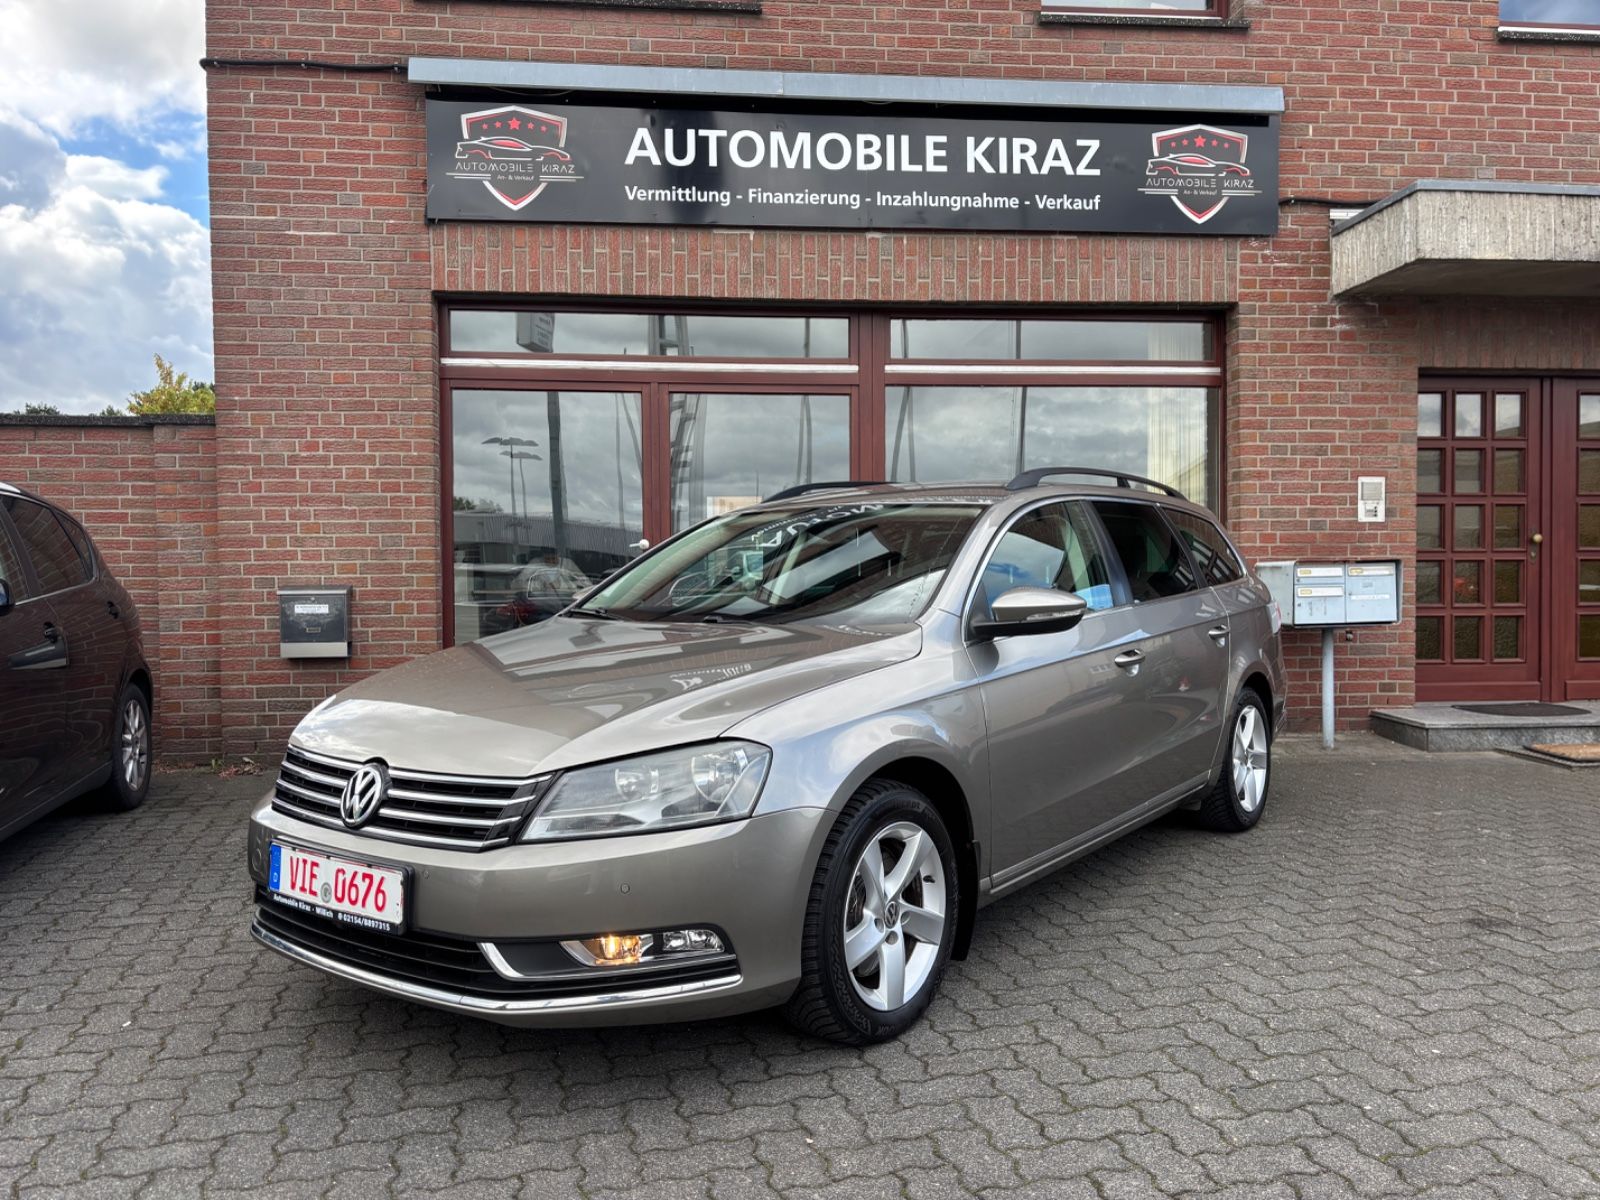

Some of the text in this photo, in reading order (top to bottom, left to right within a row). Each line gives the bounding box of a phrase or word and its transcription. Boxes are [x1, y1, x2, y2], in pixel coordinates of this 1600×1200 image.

[624, 127, 1101, 176] AUTOMOBILE KIRAZ
[455, 161, 575, 174] AUTOMOBILE KIRAZ
[1146, 177, 1254, 188] AUTOMOBILE KIRAZ
[624, 185, 731, 207] Vermittlung
[748, 187, 861, 211] Finanzierung
[876, 190, 1020, 213] Inzahlungnahme
[1034, 194, 1102, 211] Verkauf
[289, 854, 388, 913] VIE 0676
